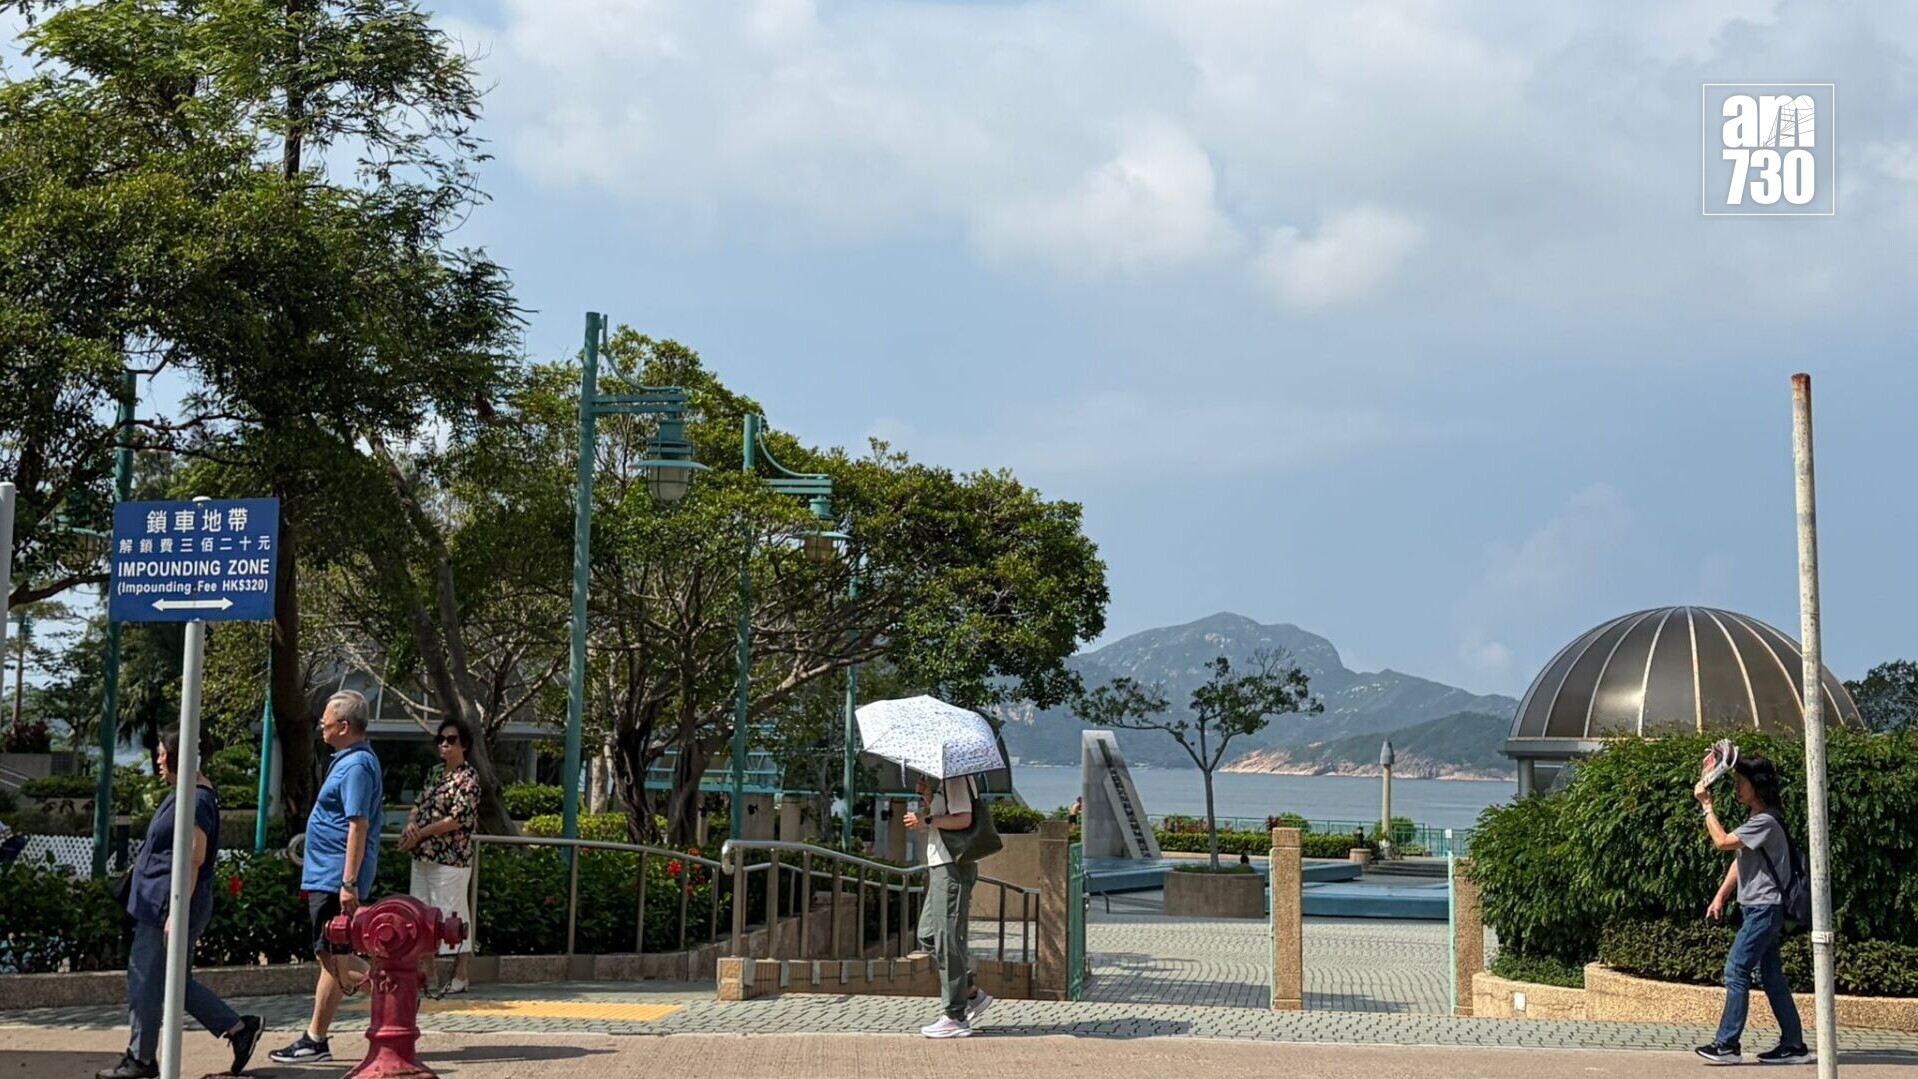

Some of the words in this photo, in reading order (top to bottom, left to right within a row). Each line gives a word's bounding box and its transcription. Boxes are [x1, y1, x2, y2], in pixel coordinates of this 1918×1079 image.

[146, 507, 248, 534] 鎖車地帶
[119, 535, 271, 554] 解鎖費三佰二十元
[118, 560, 221, 577] IMPOUNDING
[227, 559, 270, 575] ZONE
[117, 580, 192, 595] (Impounding
[197, 580, 217, 592] Fee
[222, 578, 268, 593] HK$320)
